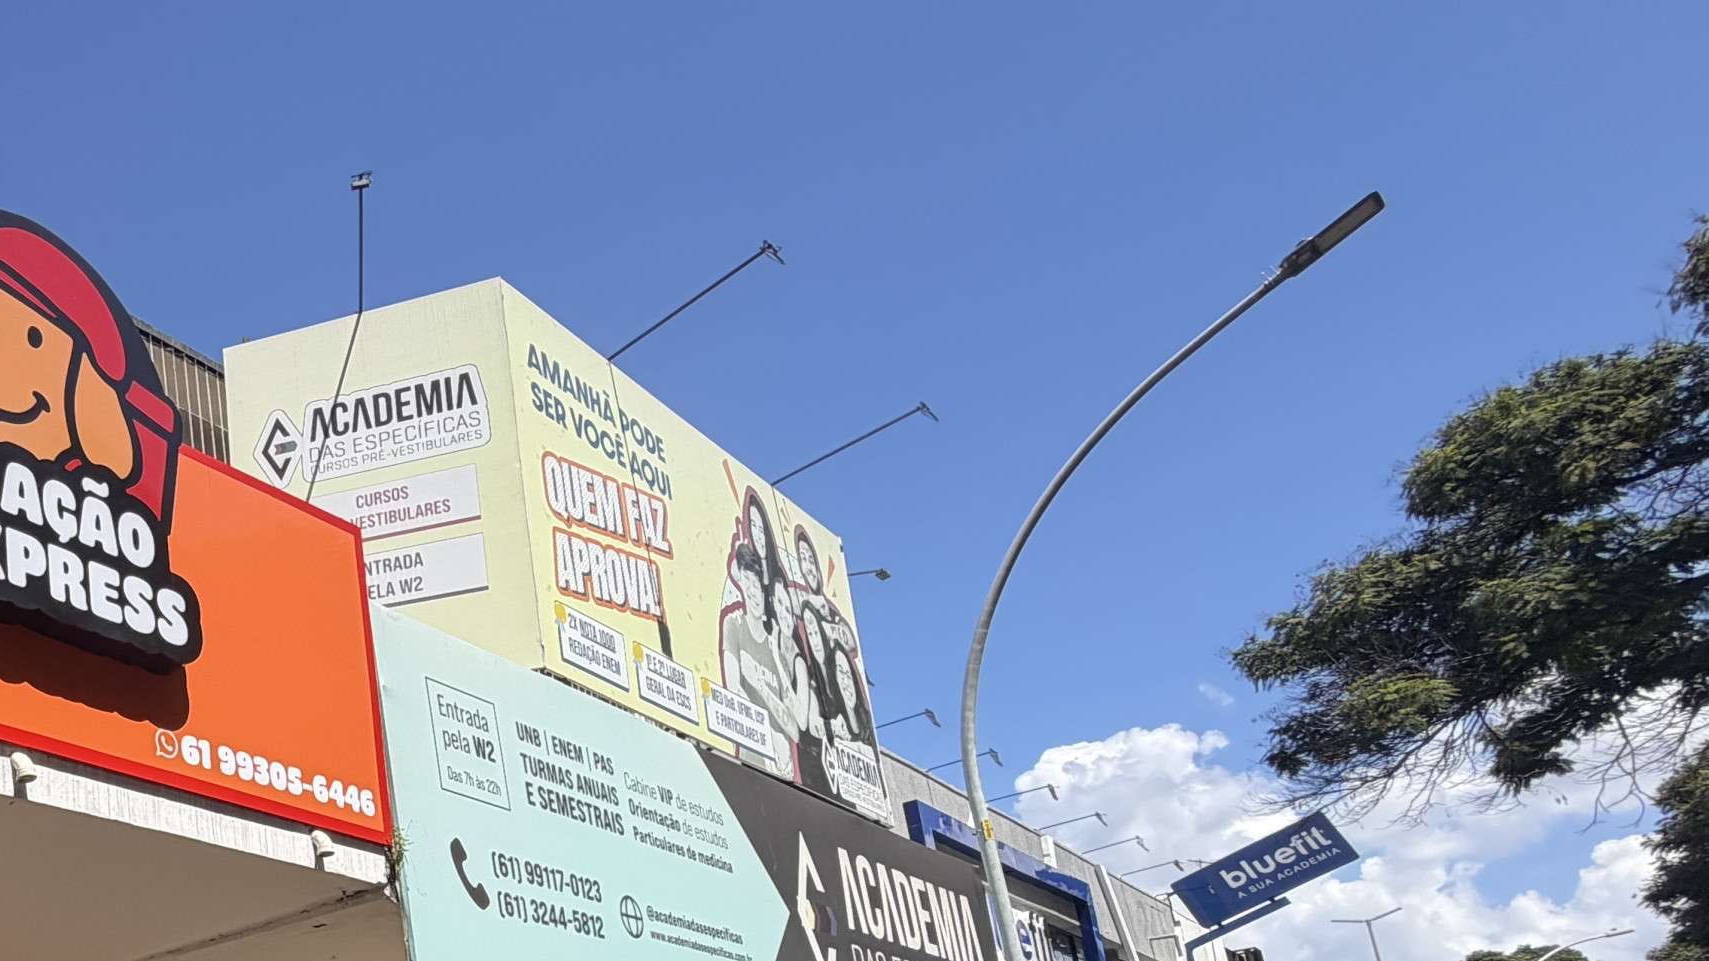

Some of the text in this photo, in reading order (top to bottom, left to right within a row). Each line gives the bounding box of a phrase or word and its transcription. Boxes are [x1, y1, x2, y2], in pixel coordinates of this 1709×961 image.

[309, 372, 479, 443] ACADEMIA
[527, 343, 667, 463] AMANHÃ PODE
[309, 410, 482, 464] DAS ESPECÍFICAS
[310, 429, 484, 477] CURSOS PRÉ-VESTIBULARES
[530, 381, 673, 500] SER VOCÊ AQUI
[355, 485, 410, 509] CURSOS
[543, 454, 671, 554] QUEM FAZ
[399, 576, 424, 594] W2
[579, 618, 598, 642] NOTA
[568, 637, 621, 676] REDAÇÃO ENEM
[436, 693, 490, 734] Entrada
[442, 727, 498, 764] pela W2
[515, 720, 615, 776] UNB ENEM PAS
[180, 734, 376, 819] 61 99305-6446
[447, 765, 502, 797] Das 7h 22h
[519, 752, 621, 807] TURMAS ANUAIS
[623, 771, 726, 826] Cabine VIP de estudos
[524, 781, 626, 837] E SEMESTRAIS
[627, 798, 730, 850] Orientação de estudos
[631, 825, 735, 874] Particulares de medicina
[1219, 826, 1333, 889] bluefit
[1237, 848, 1342, 900] A SUA ACADEMIA
[490, 851, 603, 903] (61) 99117-0123
[496, 890, 606, 940] (61) 3244-5812
